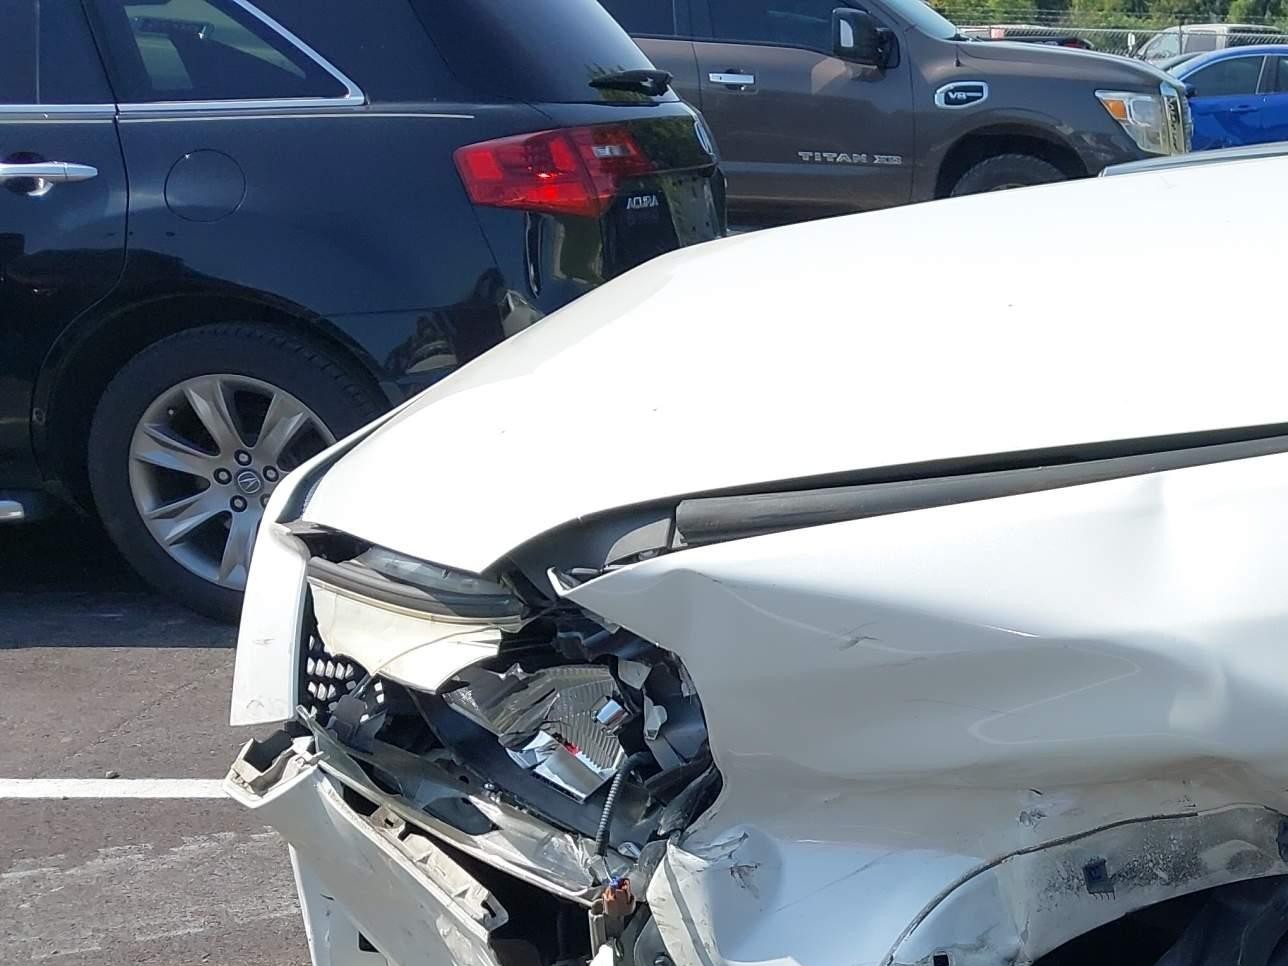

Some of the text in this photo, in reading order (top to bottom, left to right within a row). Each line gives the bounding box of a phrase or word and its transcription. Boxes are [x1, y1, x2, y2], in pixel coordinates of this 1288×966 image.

[948, 91, 967, 99] V8
[798, 152, 902, 165] TITAN XD
[626, 195, 659, 209] ACURA
